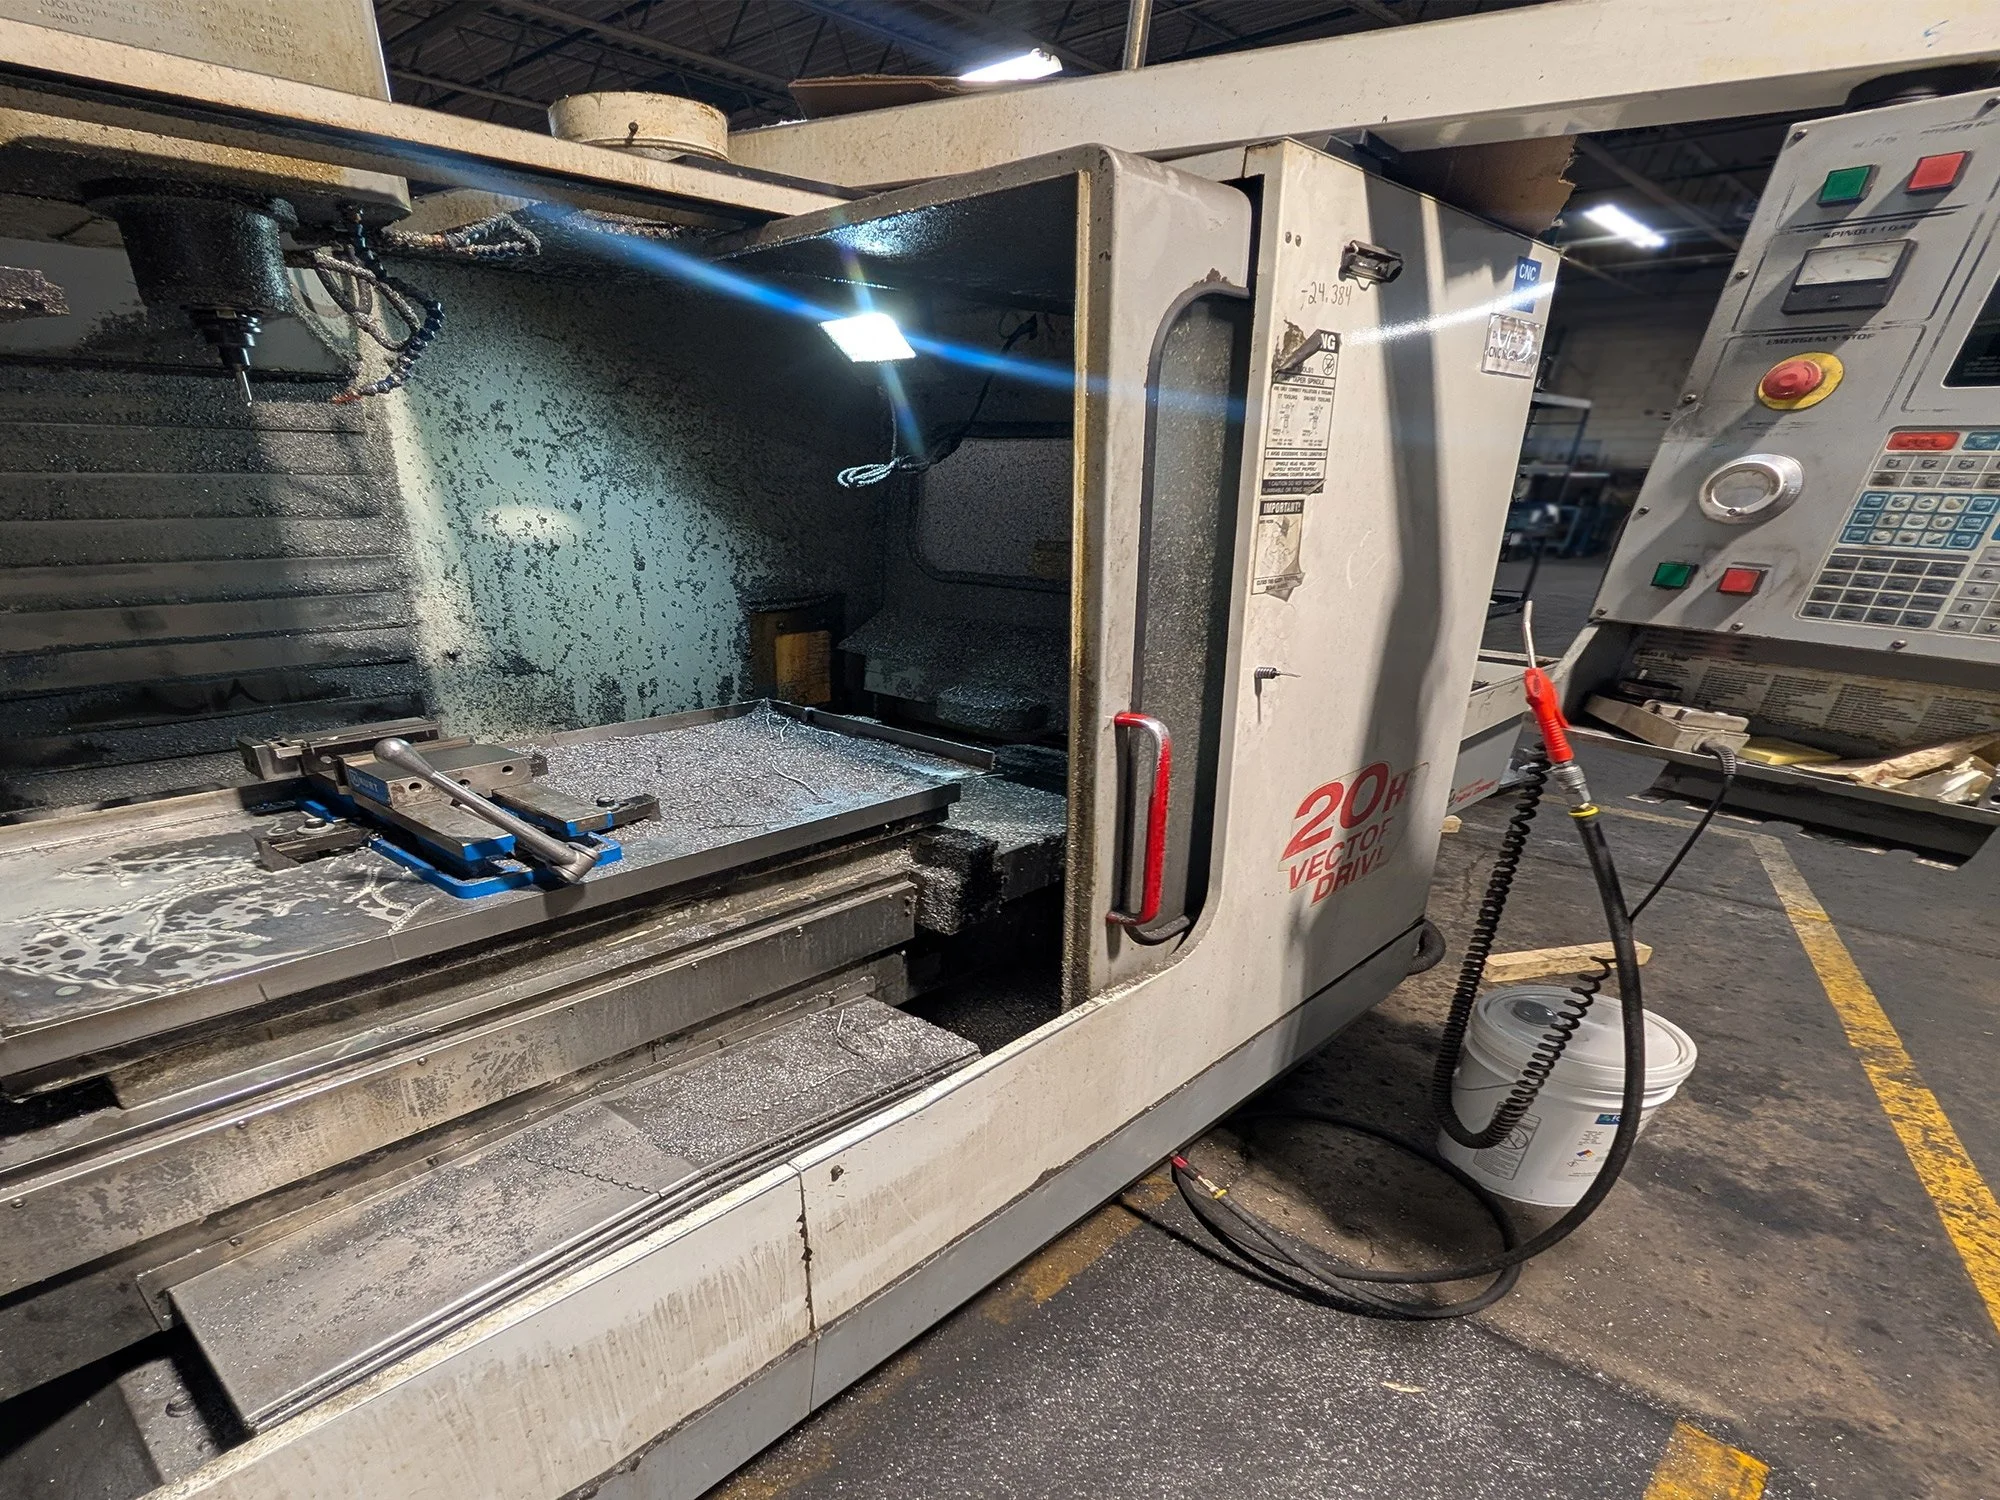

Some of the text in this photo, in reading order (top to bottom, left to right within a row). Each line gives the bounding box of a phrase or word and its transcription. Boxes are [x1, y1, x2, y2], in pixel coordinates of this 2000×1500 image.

[1519, 263, 1537, 281] CNC
[1841, 333, 1876, 343] STOP
[1263, 502, 1301, 514] IMPORTANT!
